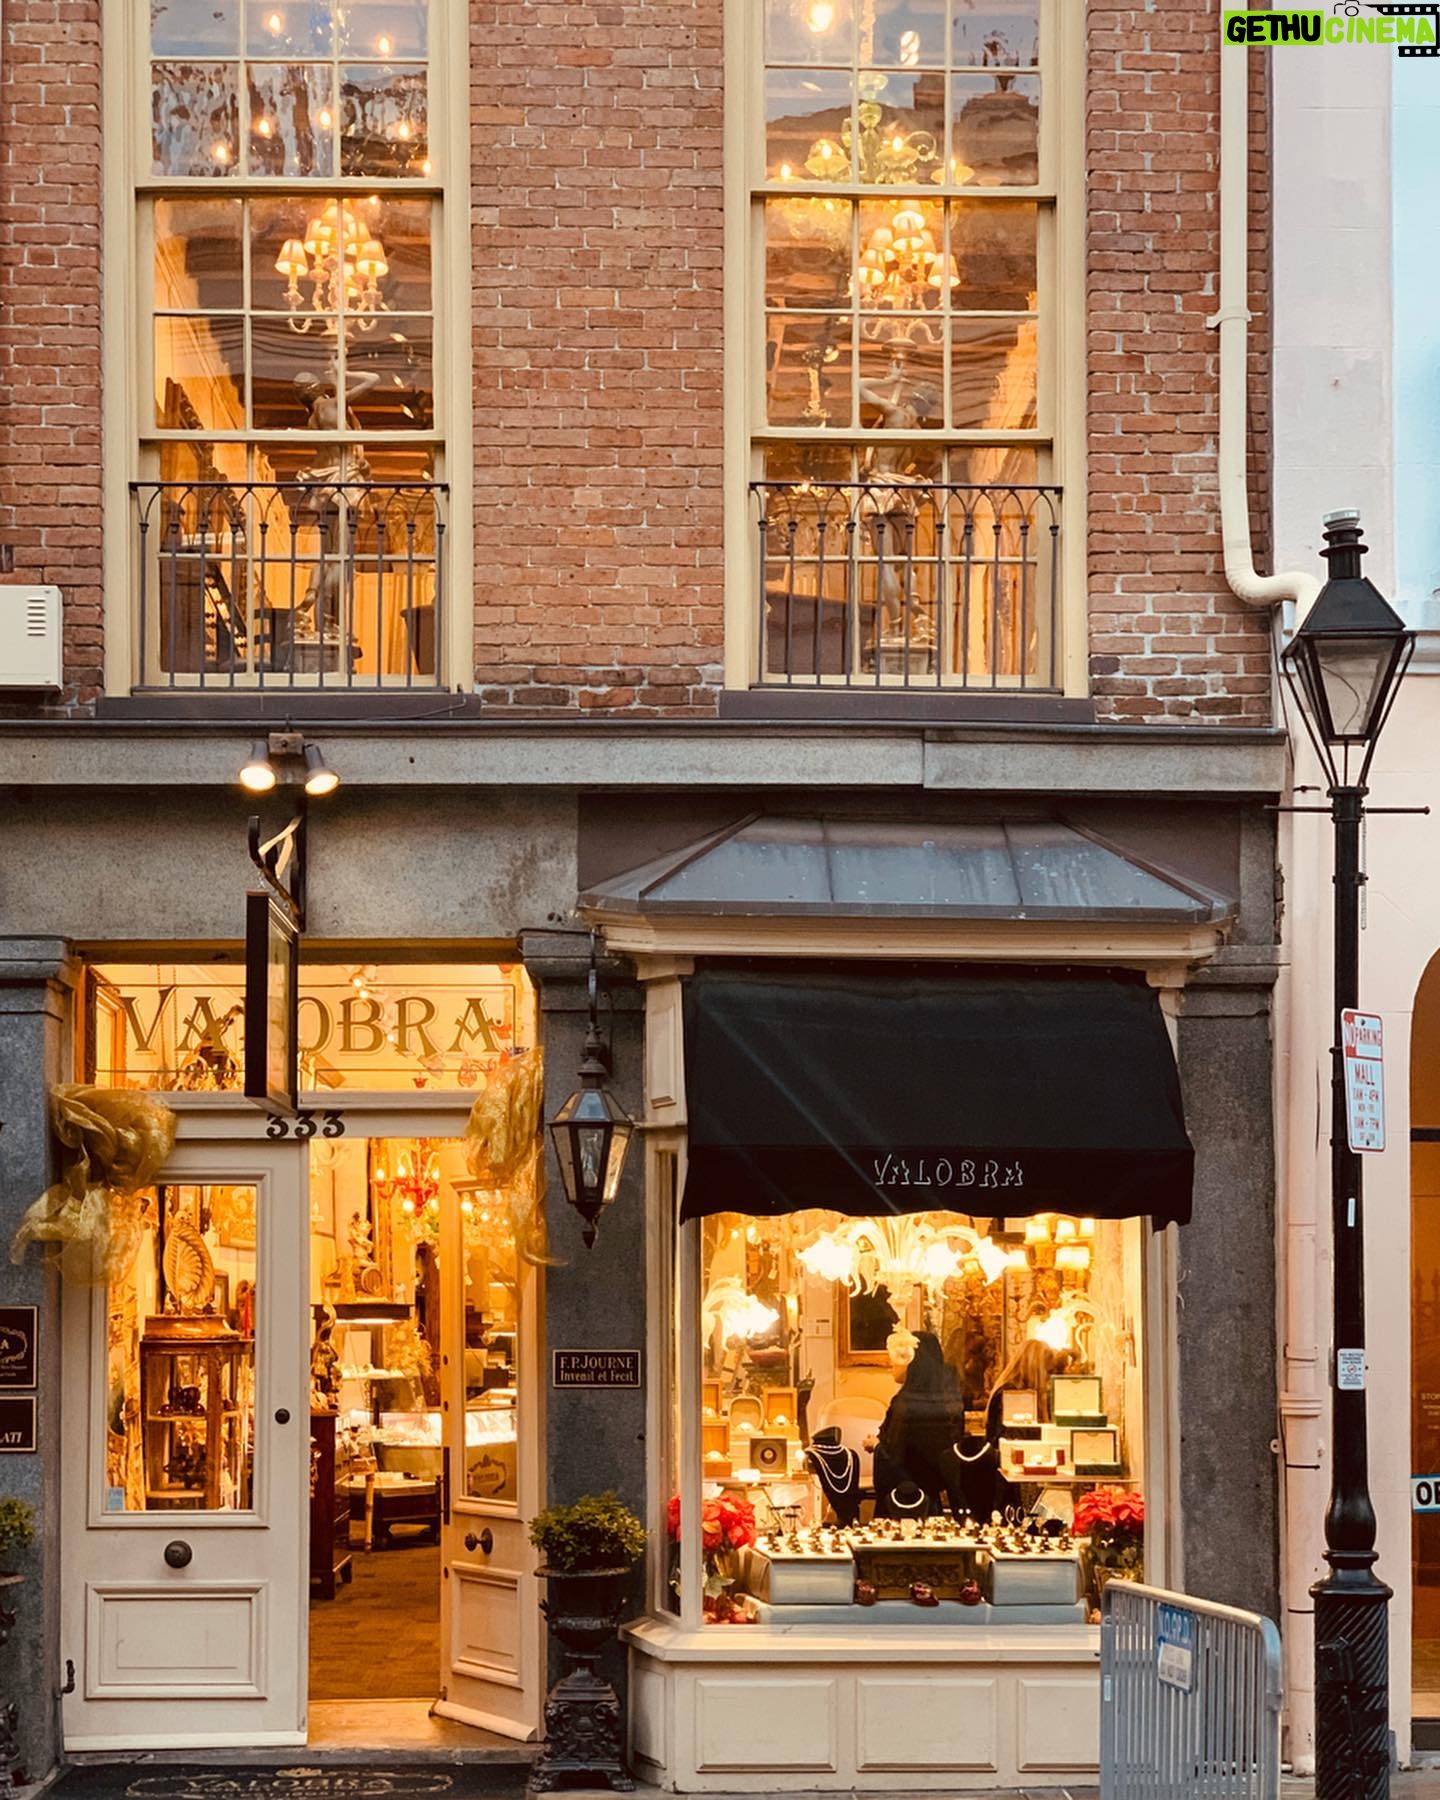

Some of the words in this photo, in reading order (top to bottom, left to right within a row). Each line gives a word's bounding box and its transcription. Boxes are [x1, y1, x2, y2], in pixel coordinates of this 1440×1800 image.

[123, 986, 500, 1056] VAOBRA
[266, 1111, 345, 1138] 333
[874, 1153, 1024, 1189] VALOBRA
